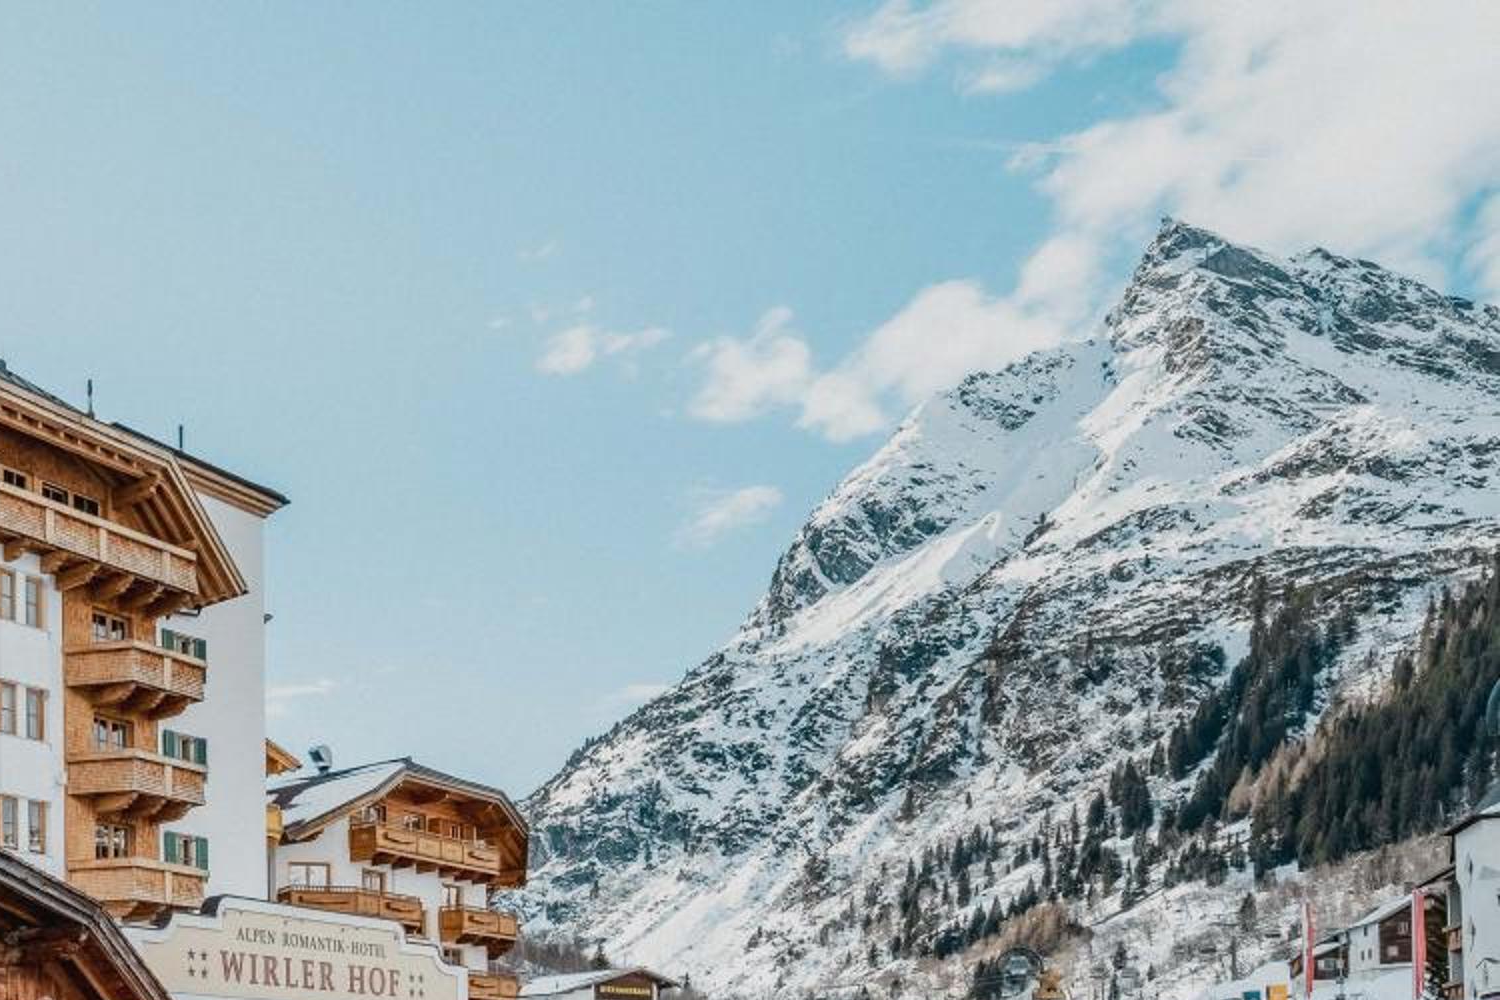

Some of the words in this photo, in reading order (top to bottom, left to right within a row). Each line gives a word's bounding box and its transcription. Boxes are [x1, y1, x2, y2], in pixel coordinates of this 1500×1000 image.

[236, 927, 276, 945] ALPEN
[219, 949, 335, 992] WIRLER
[348, 964, 400, 997] HOF
